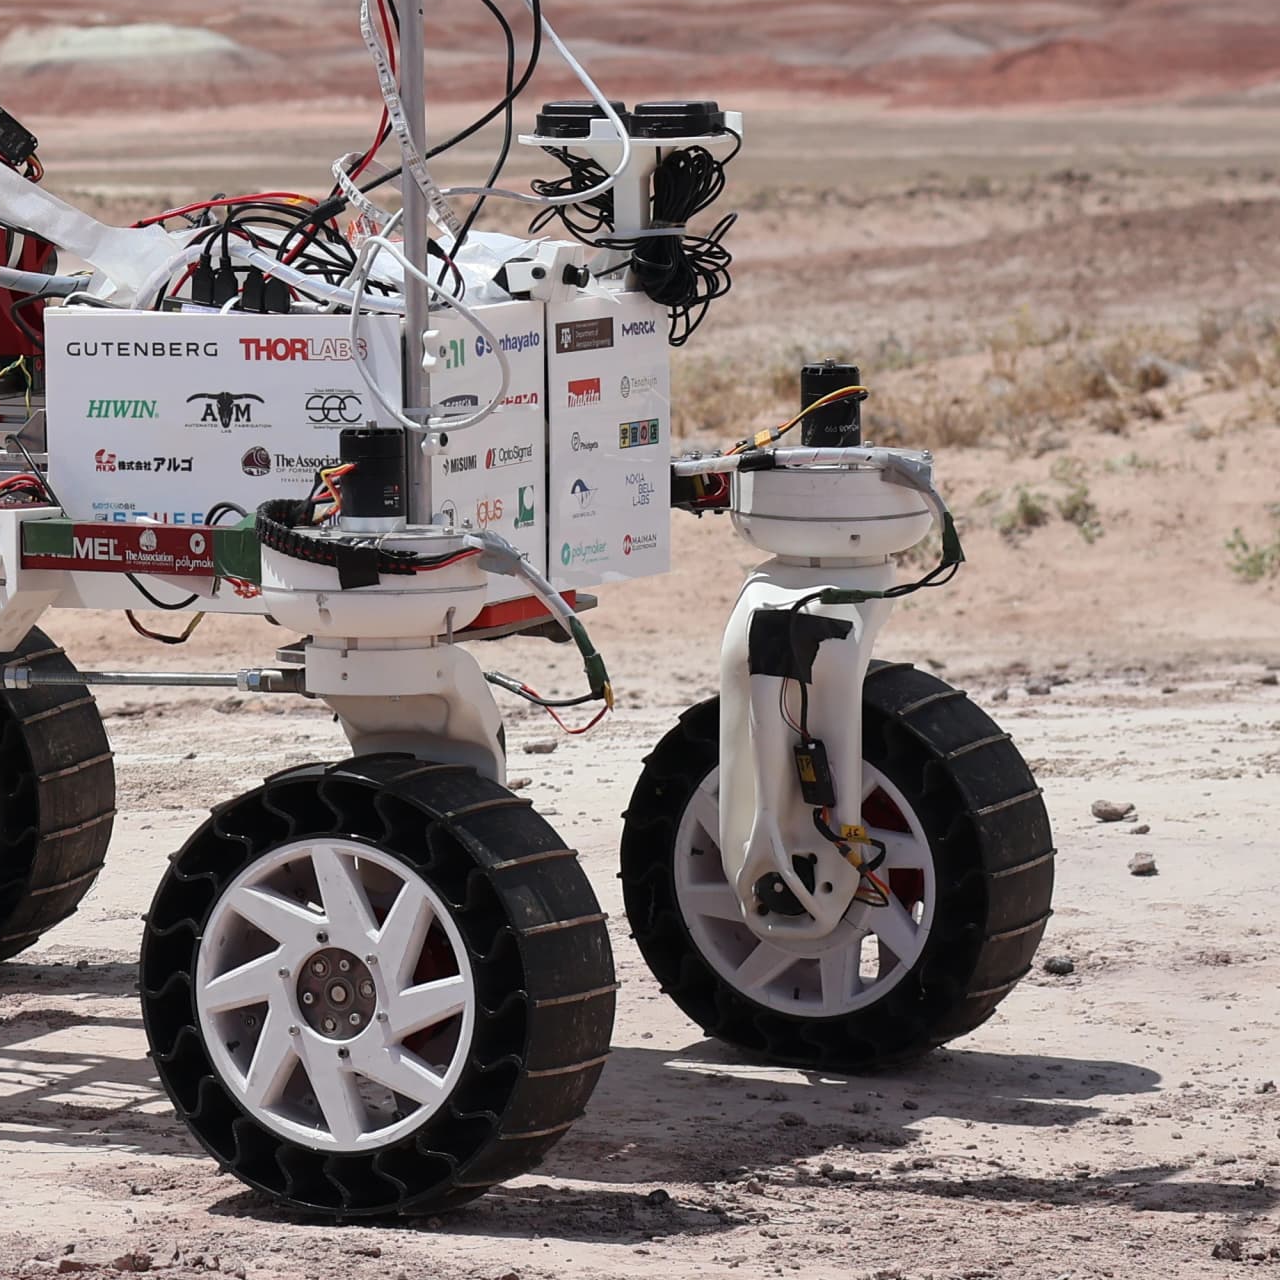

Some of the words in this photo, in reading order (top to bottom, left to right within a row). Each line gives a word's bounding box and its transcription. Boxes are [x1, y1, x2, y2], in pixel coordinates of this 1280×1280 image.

[66, 341, 219, 357] GUTENBERG
[239, 337, 368, 361] THORLABS
[485, 331, 540, 354] Snhayato
[86, 399, 158, 419] HIWIN
[273, 454, 295, 468] The
[296, 453, 340, 468] Associat
[638, 483, 655, 495] BELL
[125, 550, 138, 561] The
[138, 551, 174, 563] Association
[175, 554, 214, 572] polymak
